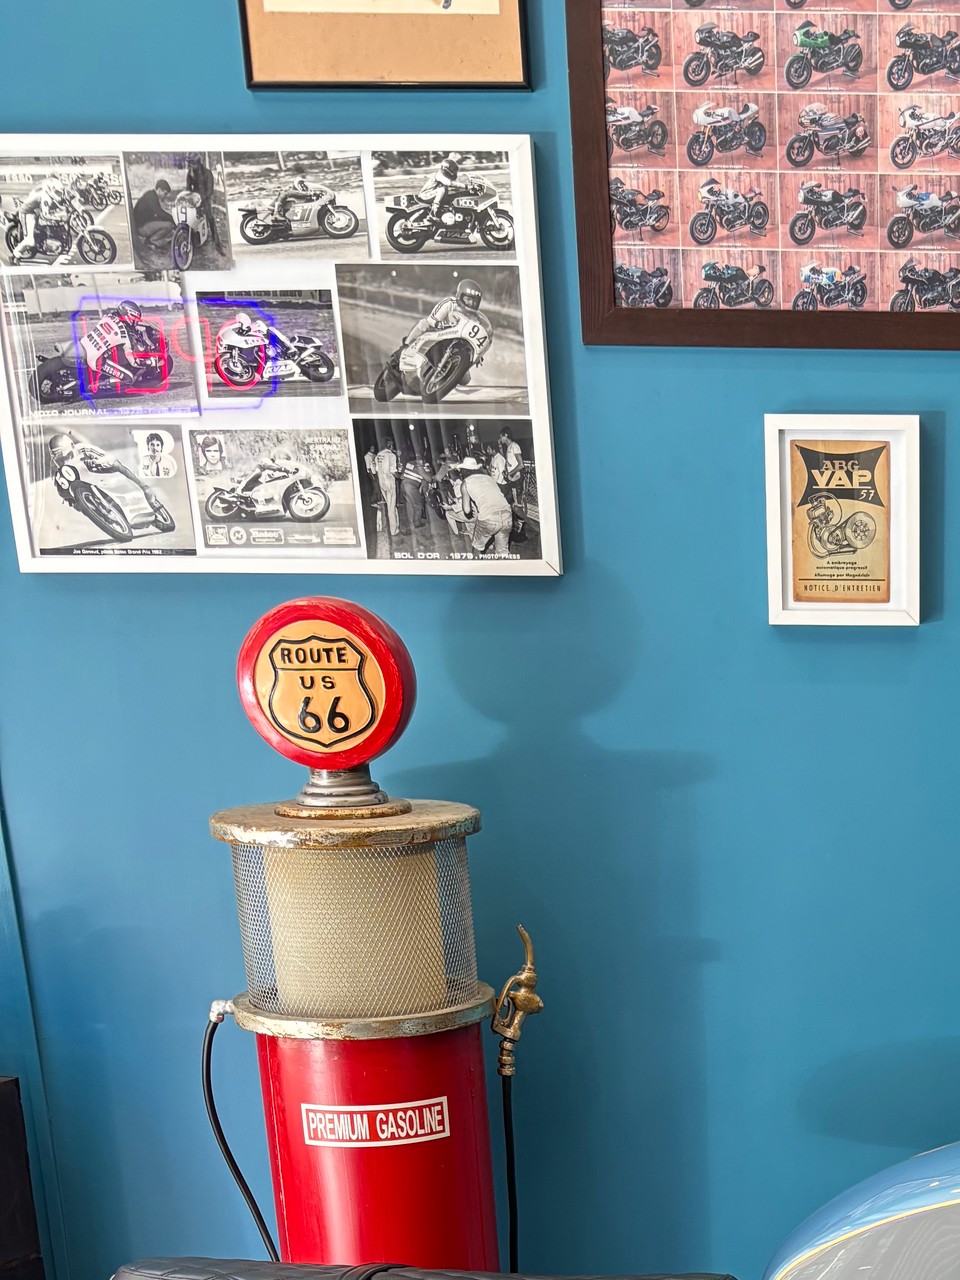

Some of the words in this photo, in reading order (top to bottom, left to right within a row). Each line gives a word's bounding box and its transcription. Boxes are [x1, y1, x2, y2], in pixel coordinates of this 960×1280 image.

[468, 323, 489, 349] 94
[60, 408, 108, 417] JOURNAL
[821, 460, 860, 472] ABG
[811, 470, 872, 488] VAP
[859, 490, 875, 501] 57
[834, 584, 881, 592] D'ENTRETIEN
[280, 646, 348, 665] ROUTE
[299, 696, 350, 734] 66
[308, 1112, 370, 1141] PREMIUM
[375, 1105, 444, 1139] GASOLINE
